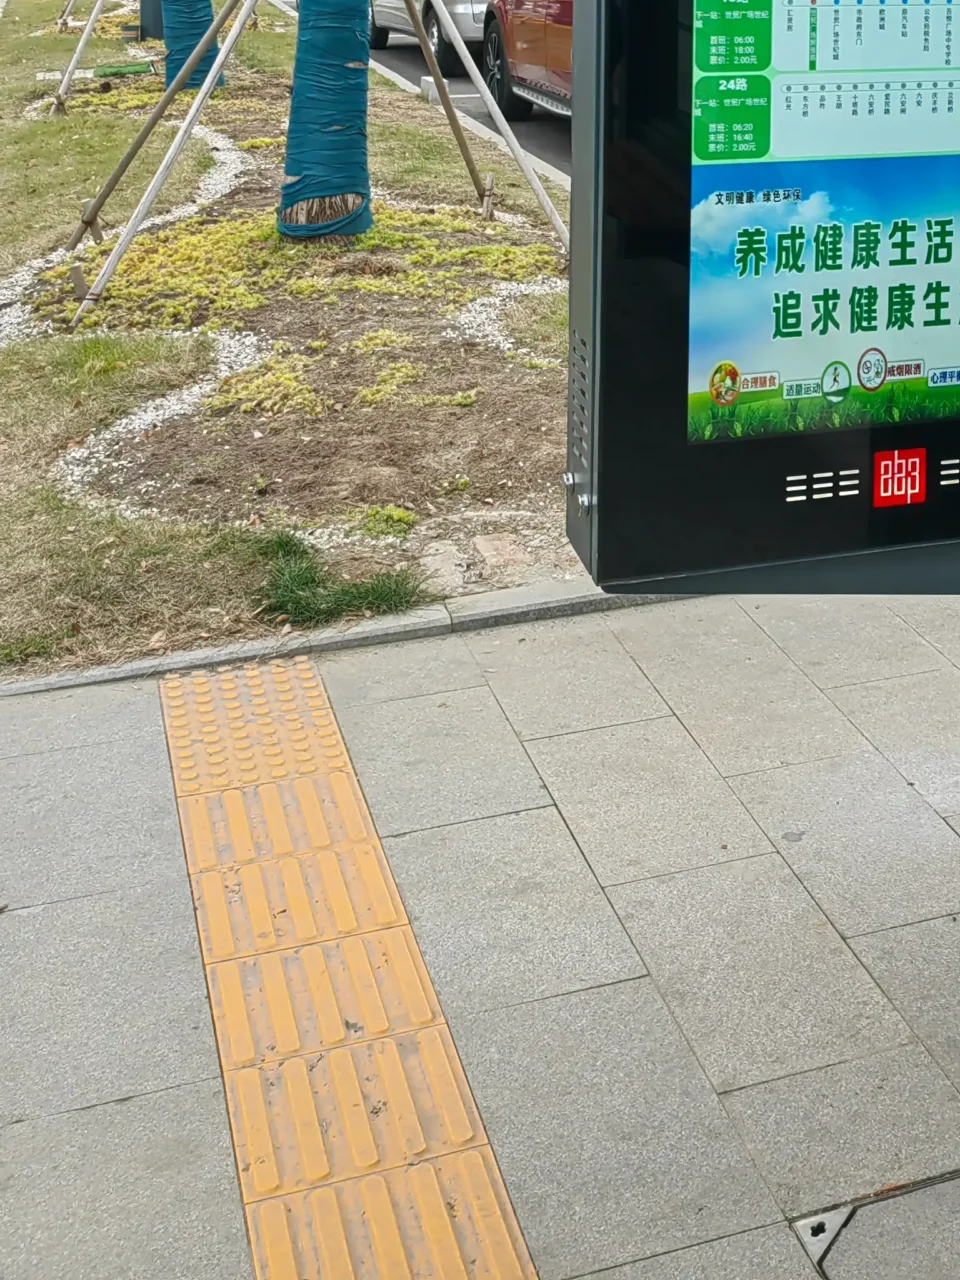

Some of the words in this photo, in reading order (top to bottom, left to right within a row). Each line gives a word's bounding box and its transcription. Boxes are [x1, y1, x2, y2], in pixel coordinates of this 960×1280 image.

[718, 78, 748, 91] 24路
[715, 191, 755, 205] 文明健康
[762, 188, 802, 203] 绿色环保
[741, 375, 777, 389] 合理膳食
[785, 382, 821, 397] 适量运动
